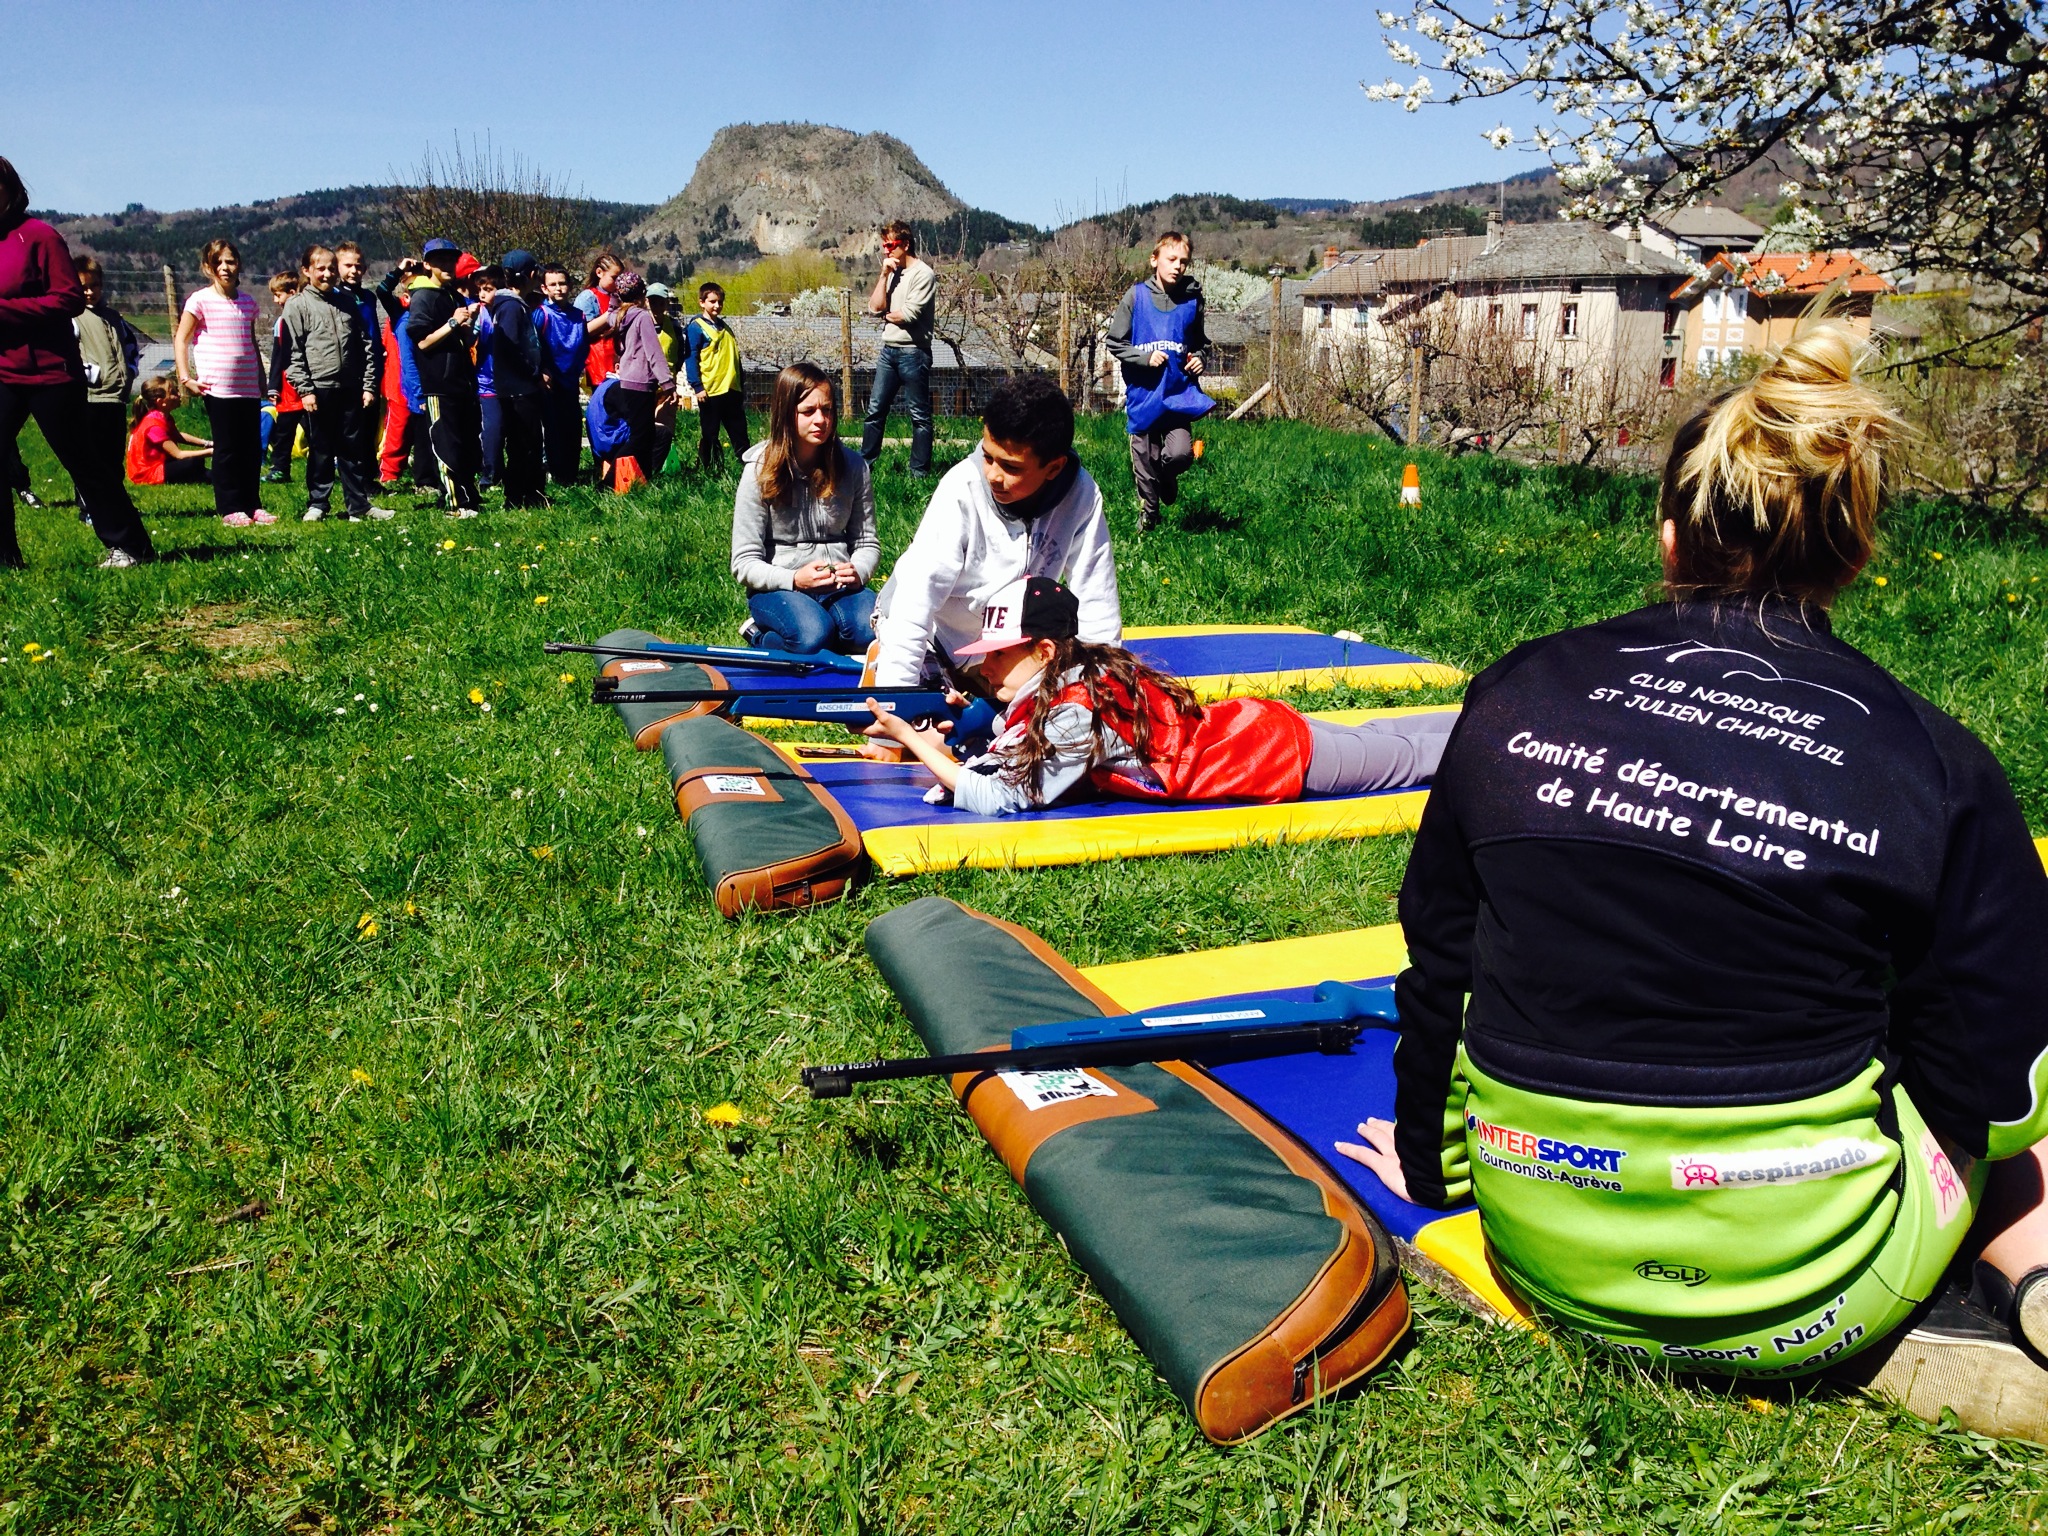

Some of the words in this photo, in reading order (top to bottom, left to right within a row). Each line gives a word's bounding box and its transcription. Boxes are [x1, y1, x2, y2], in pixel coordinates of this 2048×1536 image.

[1588, 687, 1624, 702] ST
[1624, 694, 1713, 725] JULIEN
[1716, 716, 1845, 766] CHAPTEUIL
[1629, 673, 1687, 694] CLUB
[1689, 686, 1825, 730] NORDIQUE
[1507, 731, 1608, 773] Comité
[1617, 758, 1880, 856] départemental
[1536, 777, 1575, 807] de
[1586, 787, 1692, 837] Haute
[1706, 818, 1807, 870] Loire
[1477, 1118, 1622, 1172] INTERSPORT
[1479, 1146, 1622, 1192] Tournon/St-Agrève
[1722, 1147, 1867, 1182] respirando
[1663, 1343, 1760, 1361] Sport
[1773, 1296, 1846, 1353] Nat'
